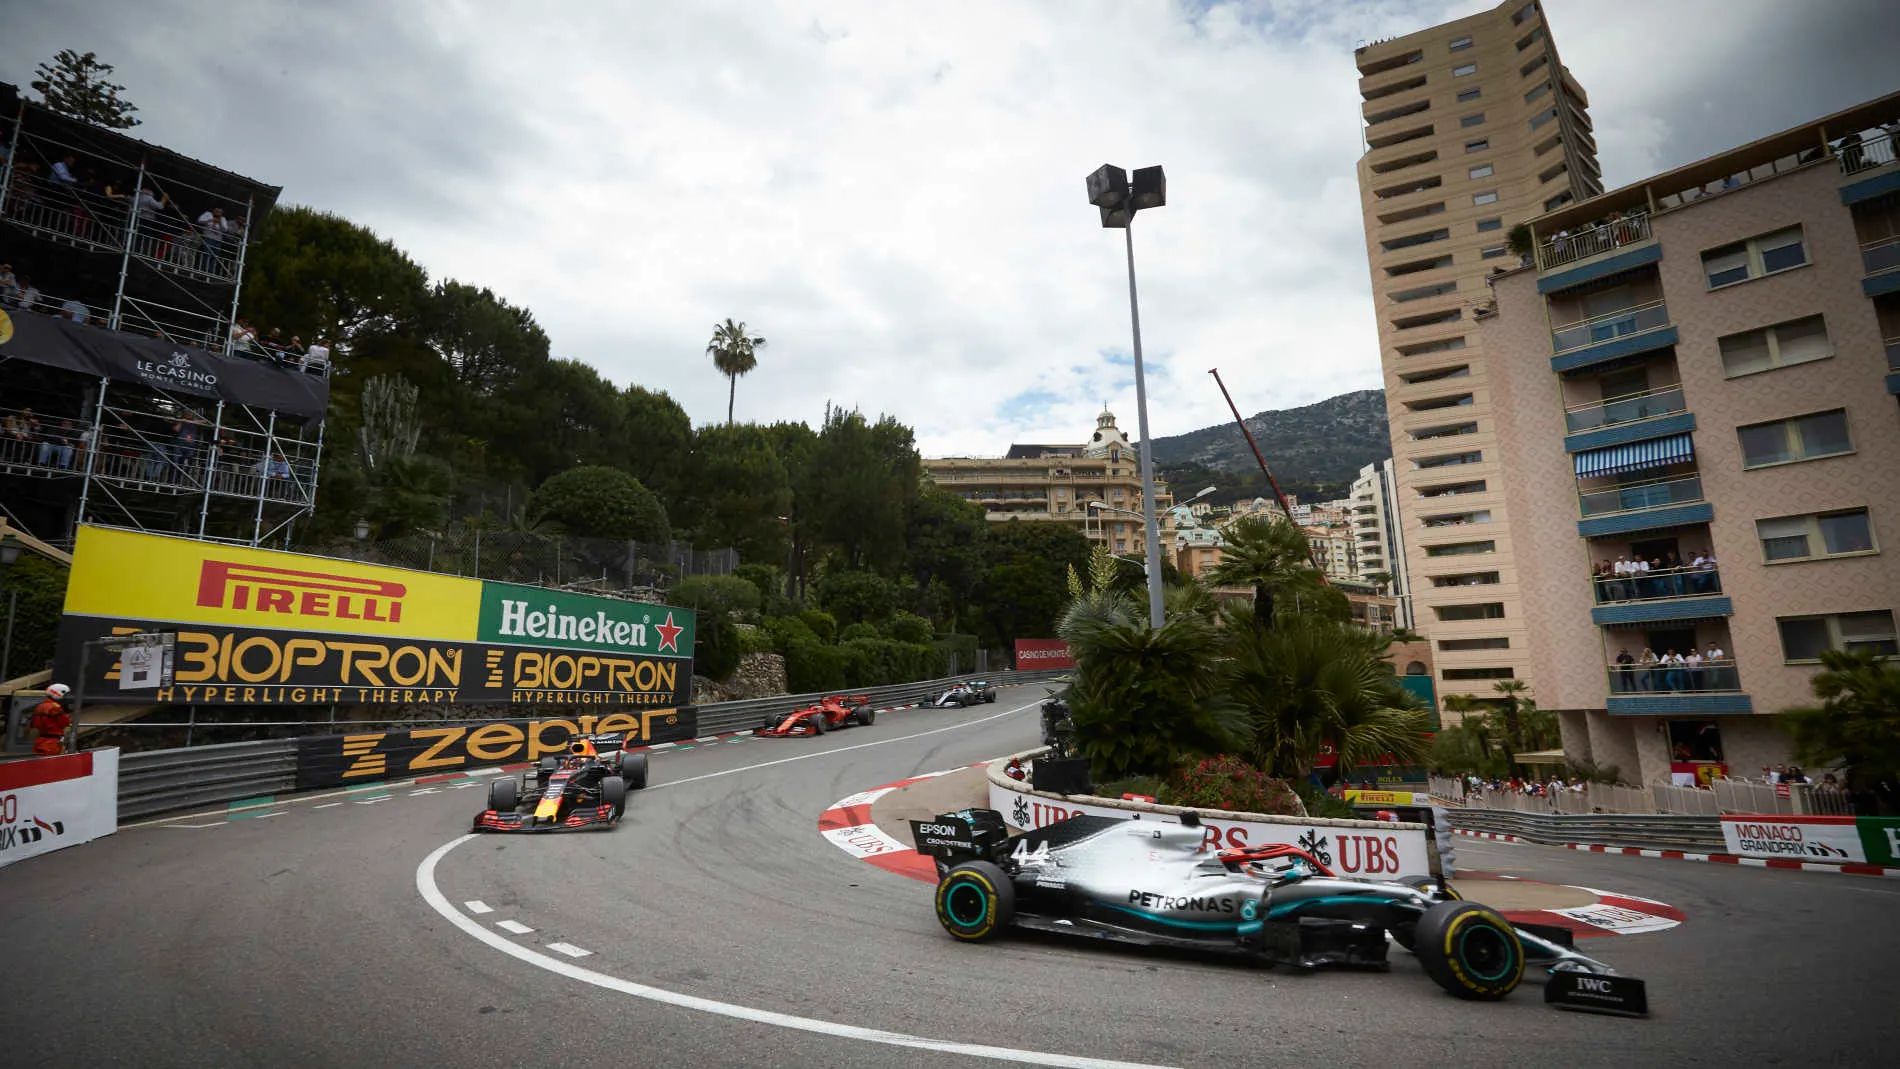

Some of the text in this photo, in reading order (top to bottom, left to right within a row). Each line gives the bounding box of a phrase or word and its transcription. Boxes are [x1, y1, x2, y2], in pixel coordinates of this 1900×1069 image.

[137, 360, 217, 384] LE CASINO
[196, 559, 407, 623] PIRELLI
[157, 685, 459, 703] HYPERLIGHT THERAPY
[512, 691, 674, 704] HYPERLIGHT THERAPY
[1361, 792, 1395, 803] PIRELLI
[919, 823, 956, 837] EPSON
[1735, 823, 1804, 842] MONACO
[848, 834, 894, 856] UBS
[926, 836, 972, 849] CROWDSTRIKE
[1011, 838, 1050, 866] 44
[1335, 834, 1400, 874] UBS
[1128, 889, 1234, 914] PETRONAS
[1576, 977, 1613, 993] IWC
